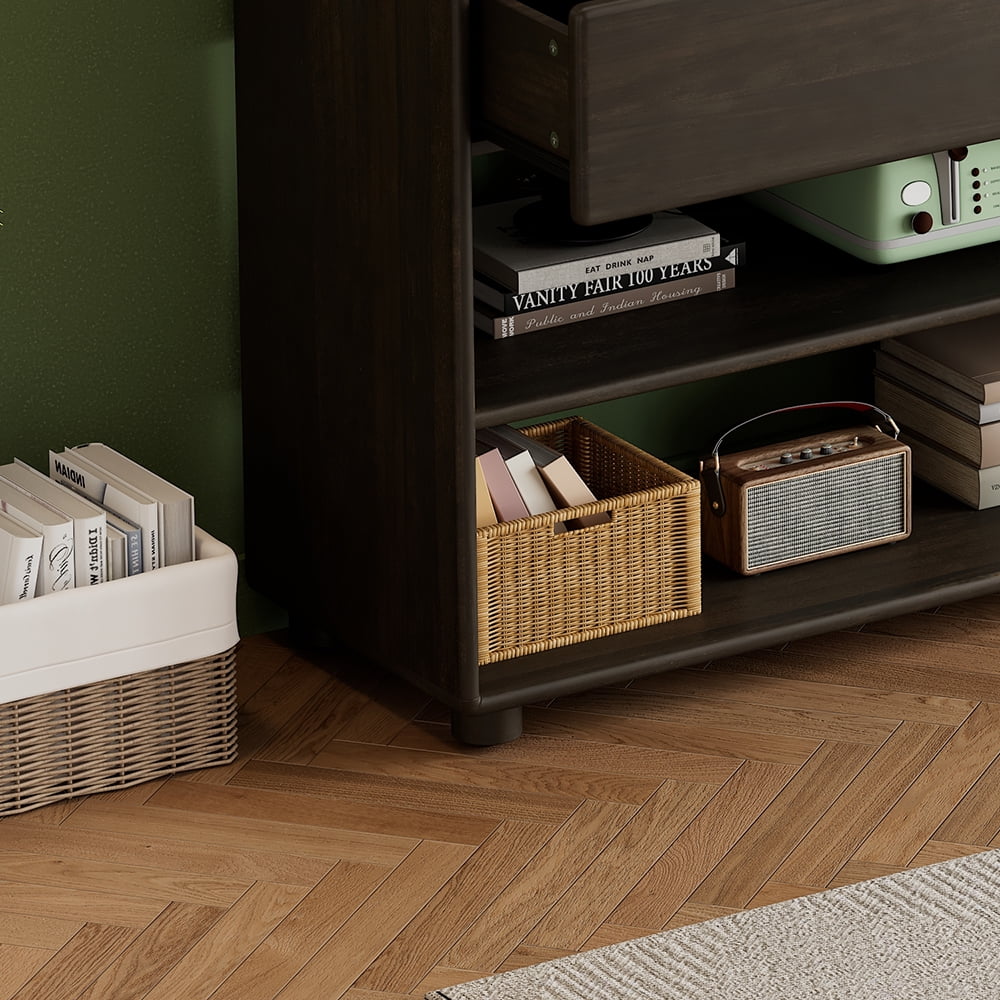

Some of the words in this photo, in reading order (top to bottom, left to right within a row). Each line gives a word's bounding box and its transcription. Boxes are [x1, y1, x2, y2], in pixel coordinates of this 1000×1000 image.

[512, 283, 579, 311] VANITY
[584, 274, 624, 297] FAIR
[628, 268, 653, 287] 100
[660, 258, 712, 280] YEARS
[585, 265, 601, 274] EAT
[605, 259, 632, 270] DRINK
[636, 254, 654, 264] NAP
[525, 313, 564, 330] Public
[570, 305, 595, 319] and
[600, 298, 645, 313] Indian
[650, 285, 703, 303] Housing
